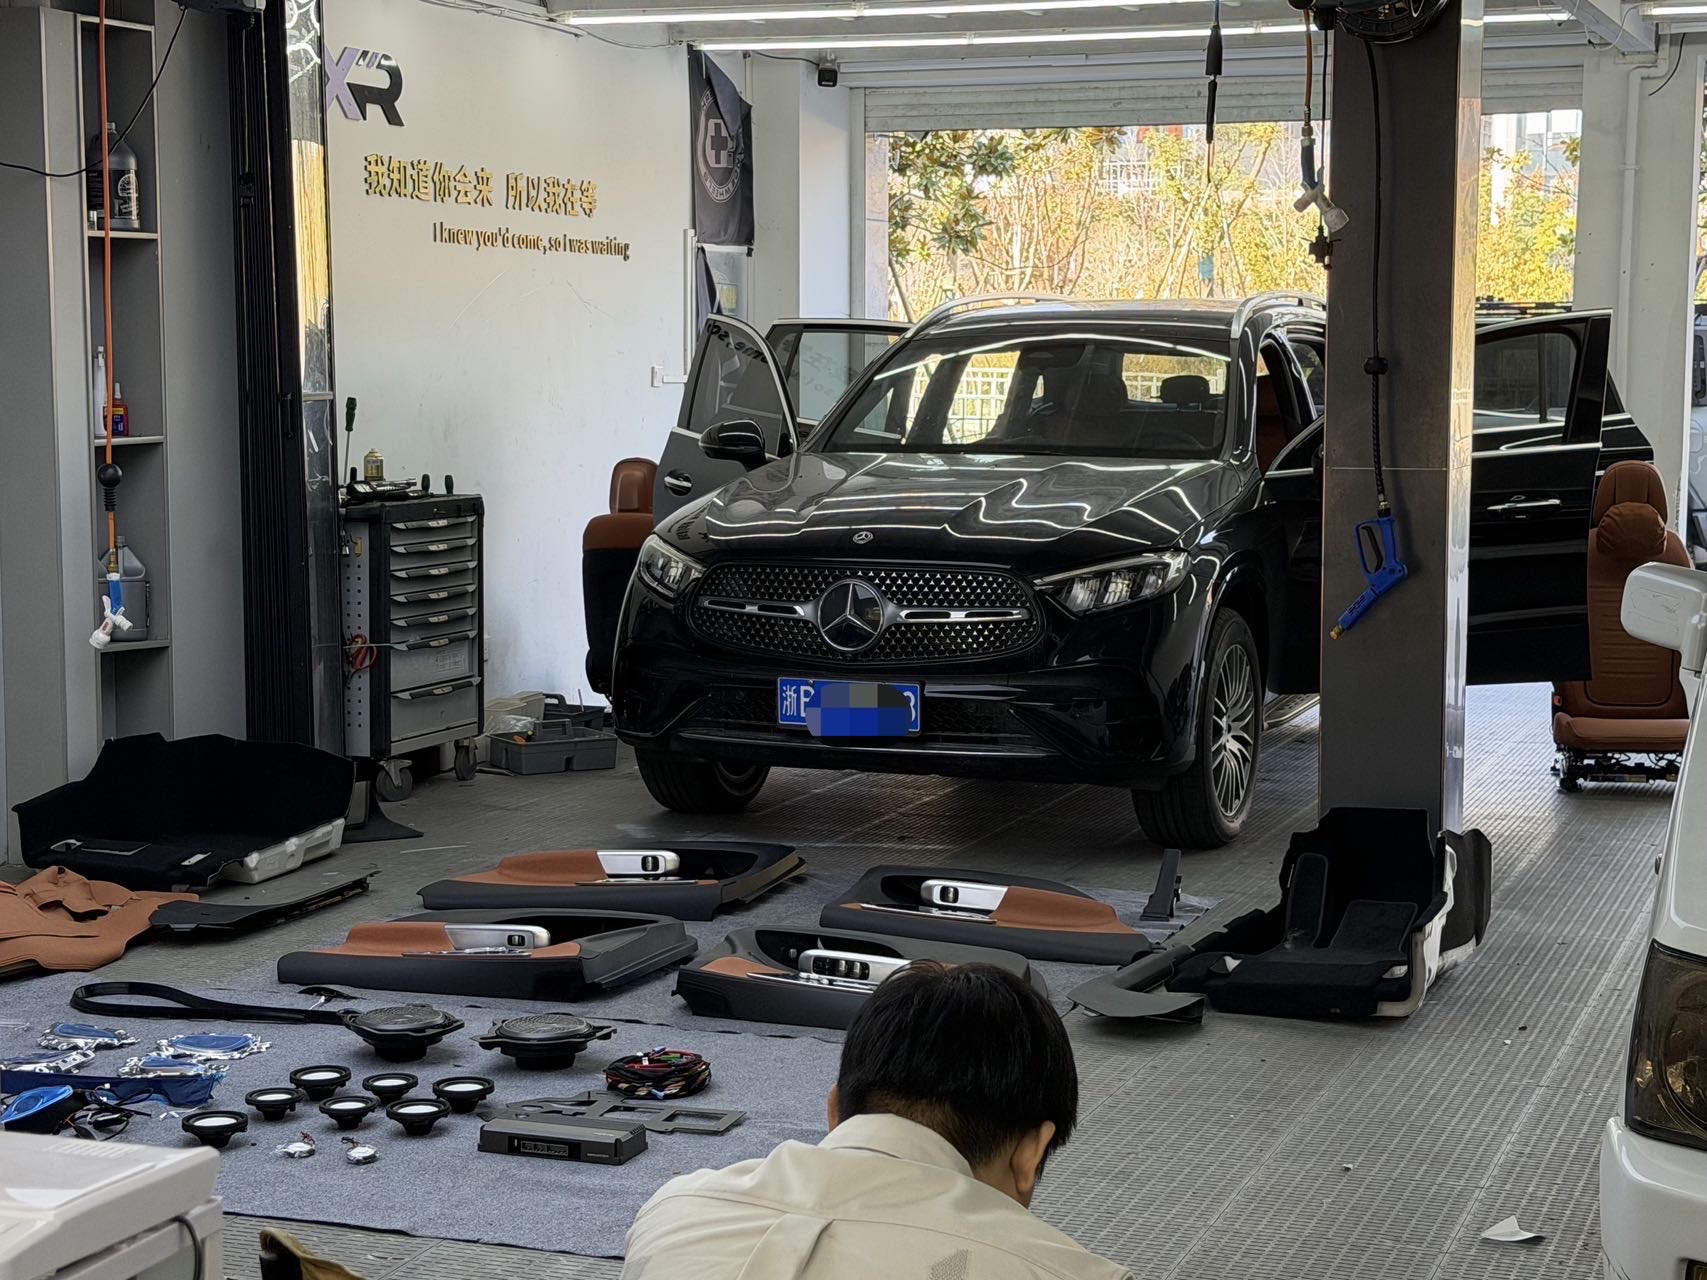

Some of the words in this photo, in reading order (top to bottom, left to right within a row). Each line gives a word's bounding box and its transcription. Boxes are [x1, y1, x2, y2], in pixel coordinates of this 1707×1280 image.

[364, 153, 494, 207] 我知道你会来
[505, 172, 599, 218] 所以我在等
[433, 222, 438, 243] I
[440, 221, 474, 246] knew
[475, 227, 510, 252] you'd
[511, 232, 547, 255] come,
[548, 236, 562, 252] so
[563, 234, 567, 252] I
[568, 238, 590, 254] was
[590, 236, 630, 262] waiting
